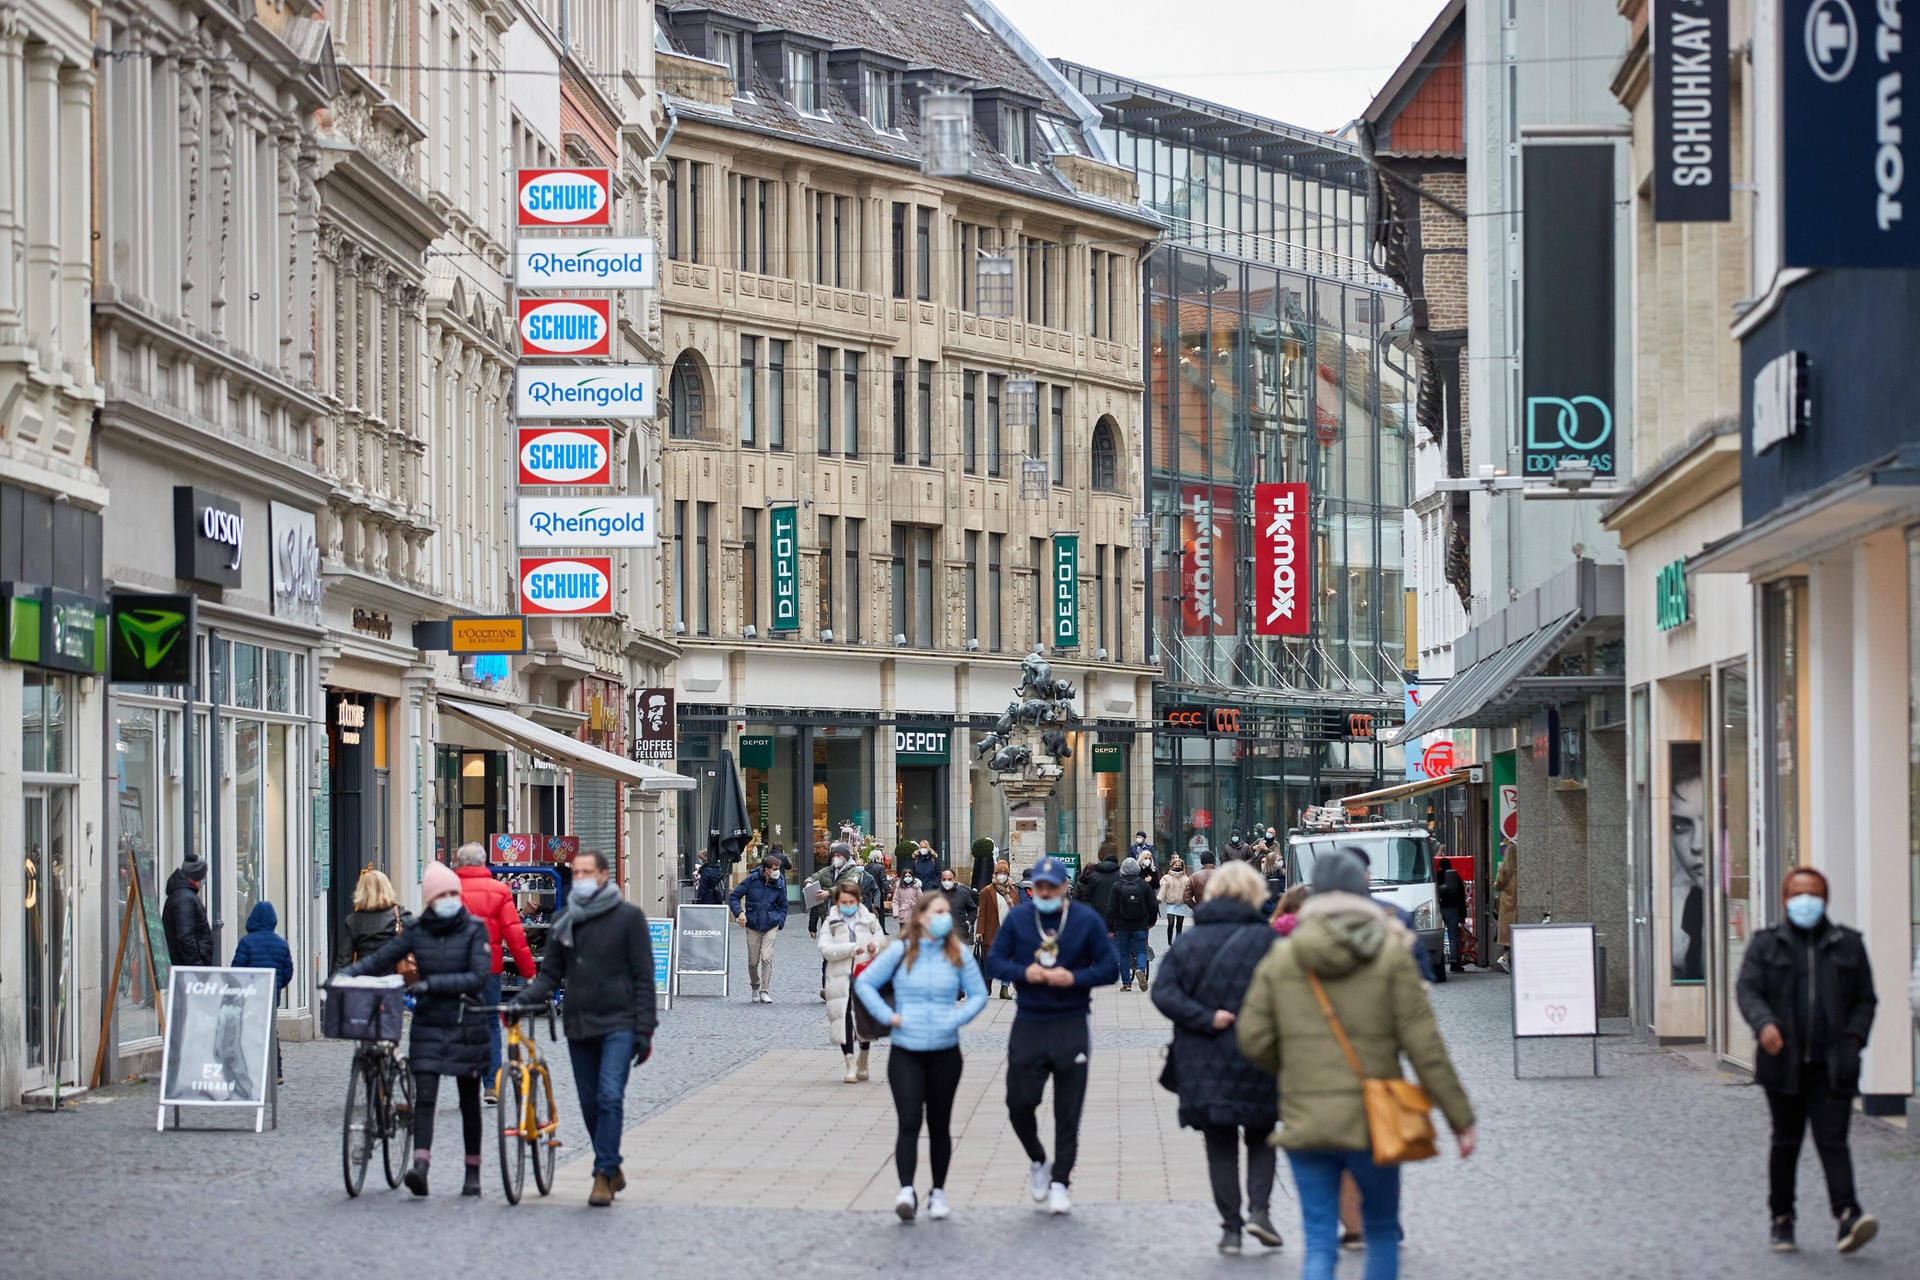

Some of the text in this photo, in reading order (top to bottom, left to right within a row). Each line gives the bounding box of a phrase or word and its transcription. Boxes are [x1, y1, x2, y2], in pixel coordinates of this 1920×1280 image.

[1672, 12, 1713, 187] SCHUHKAY
[1875, 71, 1904, 231] TOM
[529, 185, 597, 210] SCHUHE
[528, 250, 642, 277] Rheingold
[530, 315, 598, 340] SCHUHE
[528, 379, 643, 406] Rheingold
[530, 444, 598, 470] SCHUHE
[530, 510, 644, 537] Rheingold
[204, 506, 243, 570] orsay
[776, 519, 793, 618] DEPOT
[531, 573, 599, 599] SCHUHE
[1058, 546, 1072, 636] DEPOT
[1215, 708, 1241, 732] CCC
[1350, 714, 1373, 736] CCC
[635, 739, 673, 751] COFFEE
[635, 750, 673, 759] FELLOWS
[896, 732, 946, 752] DEPOT
[185, 982, 219, 995] ICH
